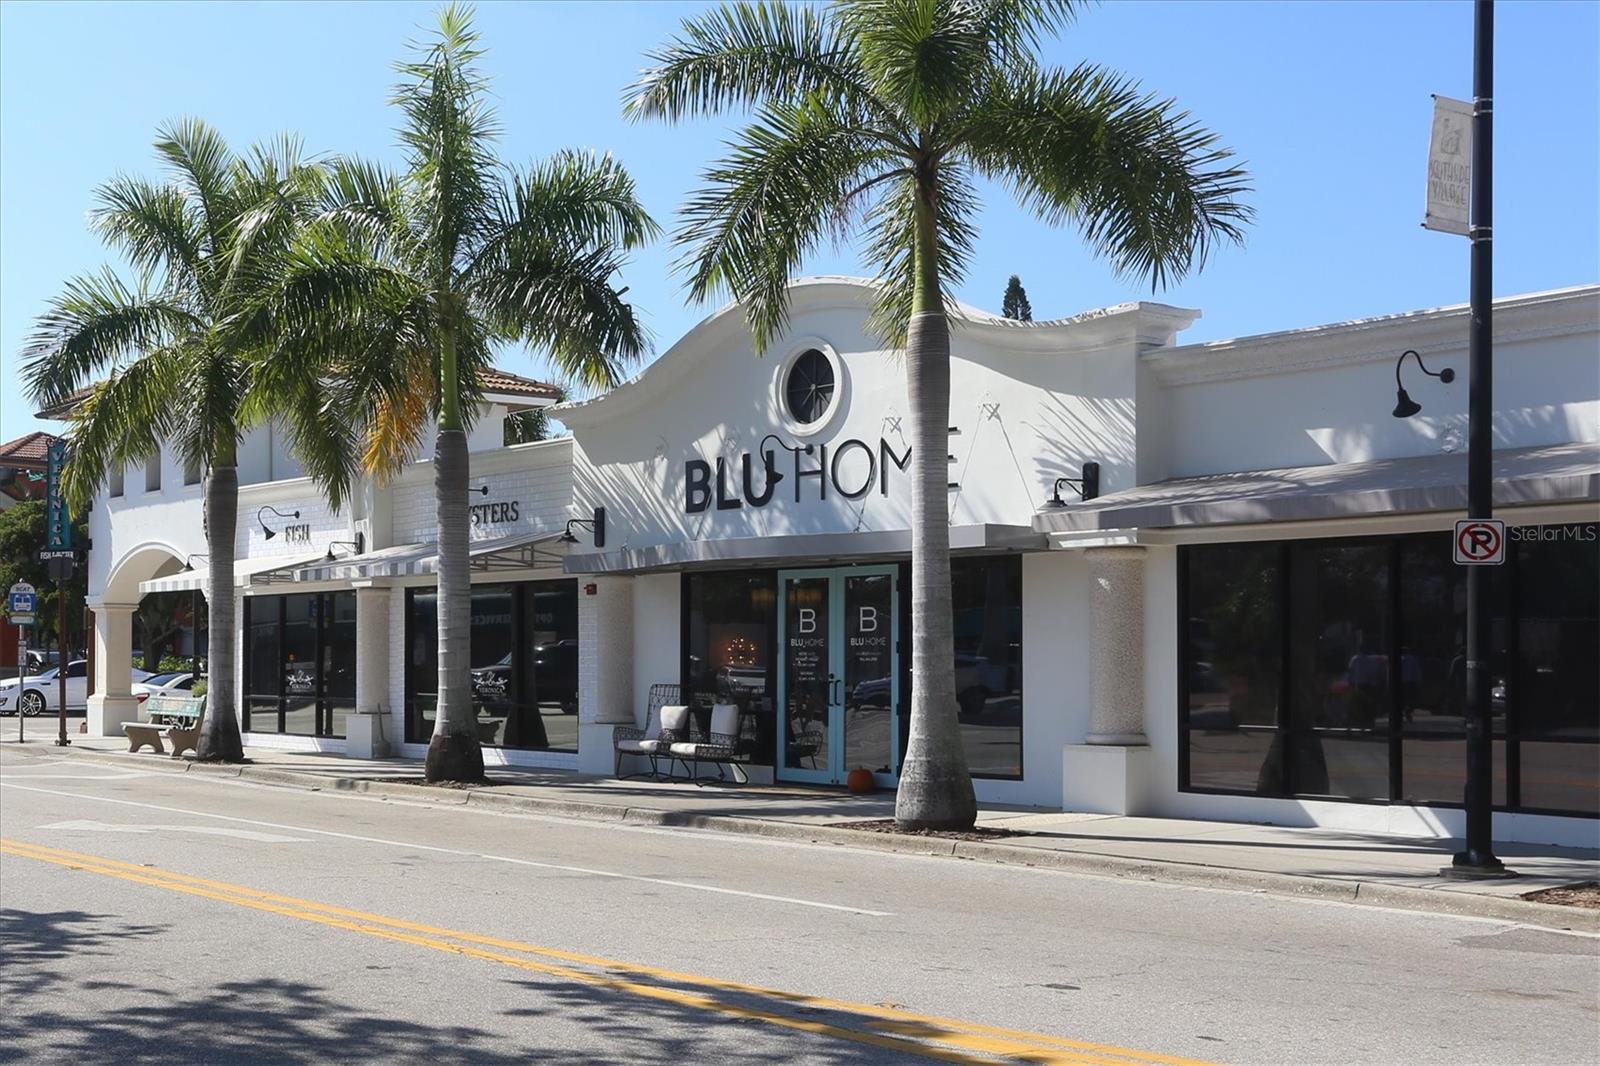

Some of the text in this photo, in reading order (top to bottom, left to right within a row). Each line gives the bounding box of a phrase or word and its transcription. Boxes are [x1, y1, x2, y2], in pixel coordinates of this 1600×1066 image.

[685, 449, 775, 514] BLU
[285, 524, 310, 542] FISH
[800, 608, 816, 633] B
[860, 606, 877, 632] B
[790, 638, 825, 647] BLU HOME
[850, 636, 887, 646] BLU HOME
